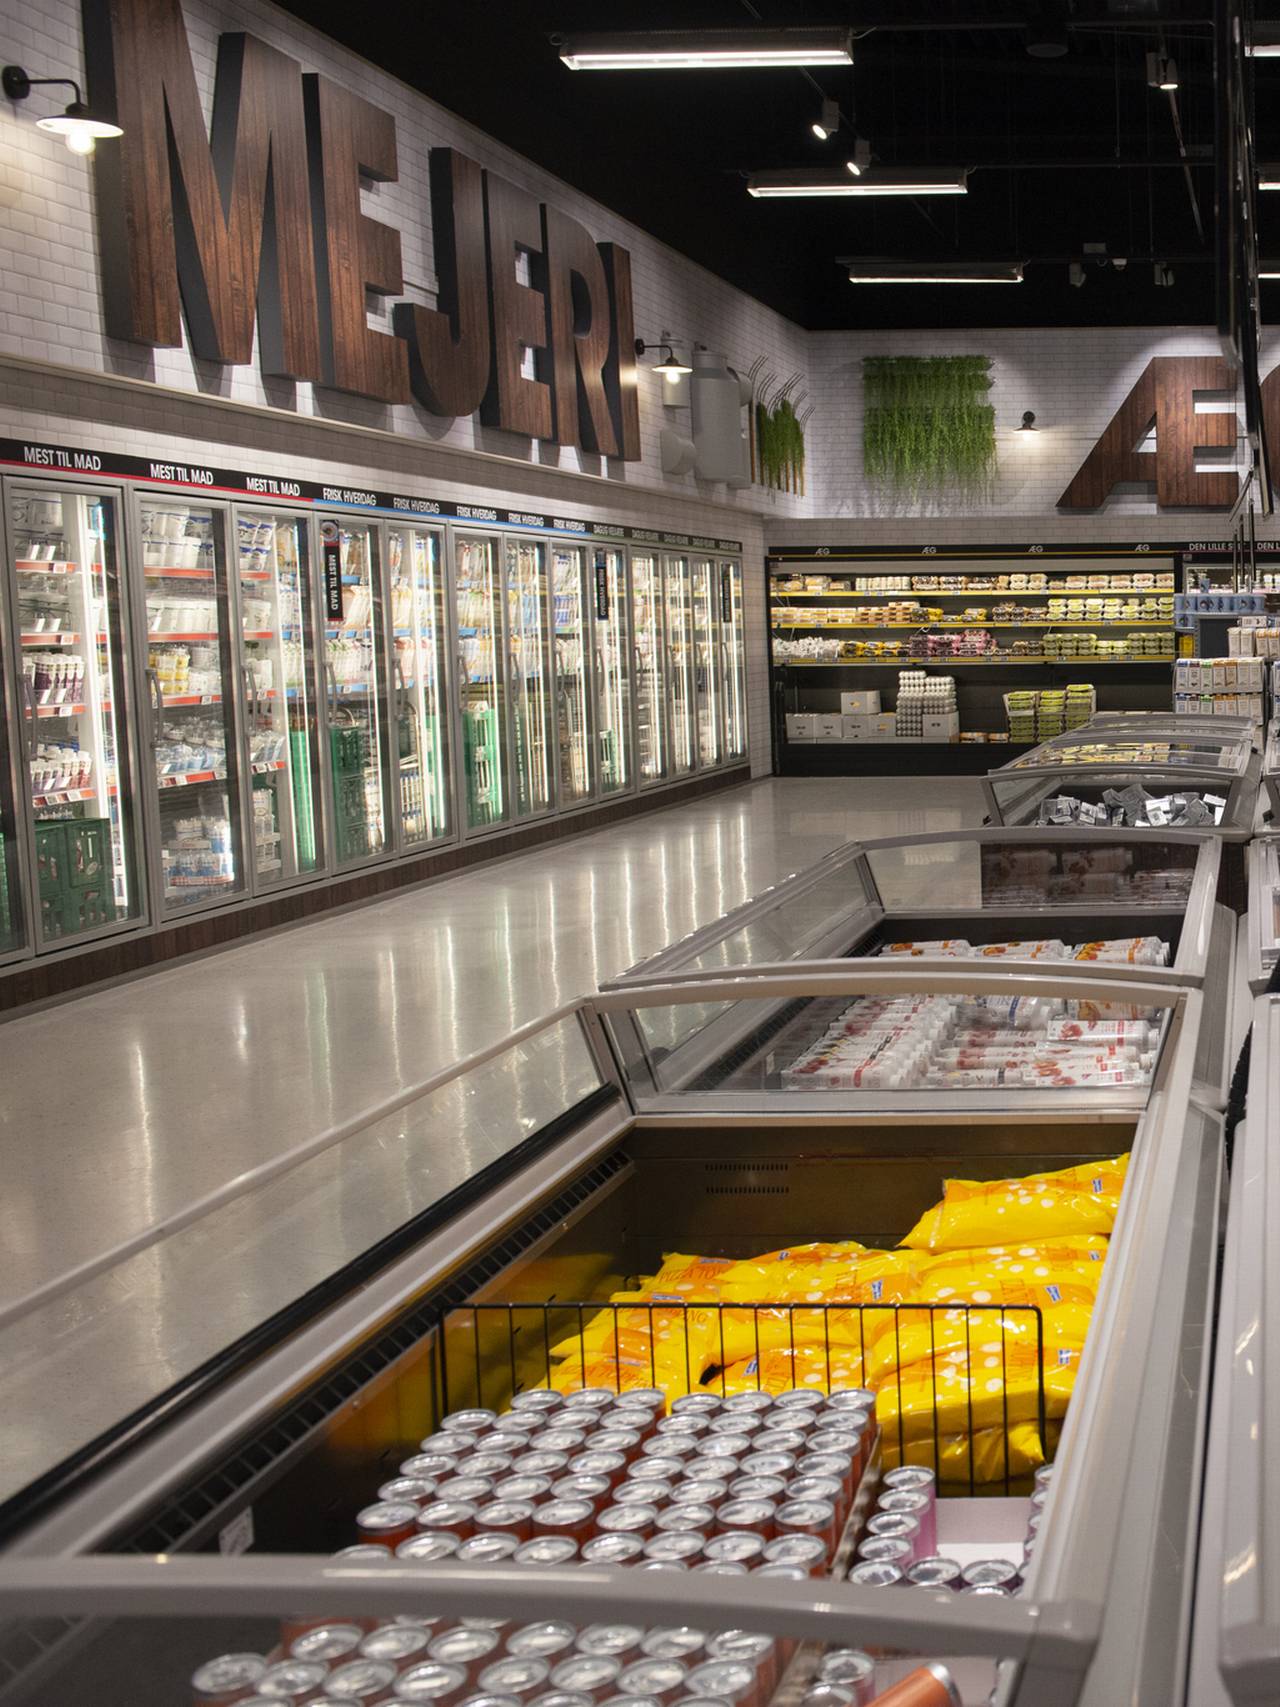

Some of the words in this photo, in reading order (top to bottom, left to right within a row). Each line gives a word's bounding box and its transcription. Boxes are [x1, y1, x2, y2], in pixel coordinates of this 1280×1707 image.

[82, 0, 640, 462] MEJERI
[24, 446, 54, 466] MEST
[56, 450, 72, 468] TIL
[74, 453, 101, 471] MAD
[150, 463, 175, 480] MEST
[176, 467, 190, 483] TIL
[191, 469, 214, 485] MAD
[246, 477, 268, 492] MEST
[268, 480, 280, 494] TIL
[281, 481, 300, 496] MAD
[323, 488, 342, 502] FRISK
[343, 489, 377, 506] HVERDAG
[393, 497, 411, 510] FRISK
[411, 499, 440, 514] HVERDAG
[456, 505, 471, 518] FRISK
[1257, 542, 1274, 550] DEN
[328, 554, 337, 575] MEST
[329, 577, 337, 589] TIL
[330, 590, 339, 610] MAD
